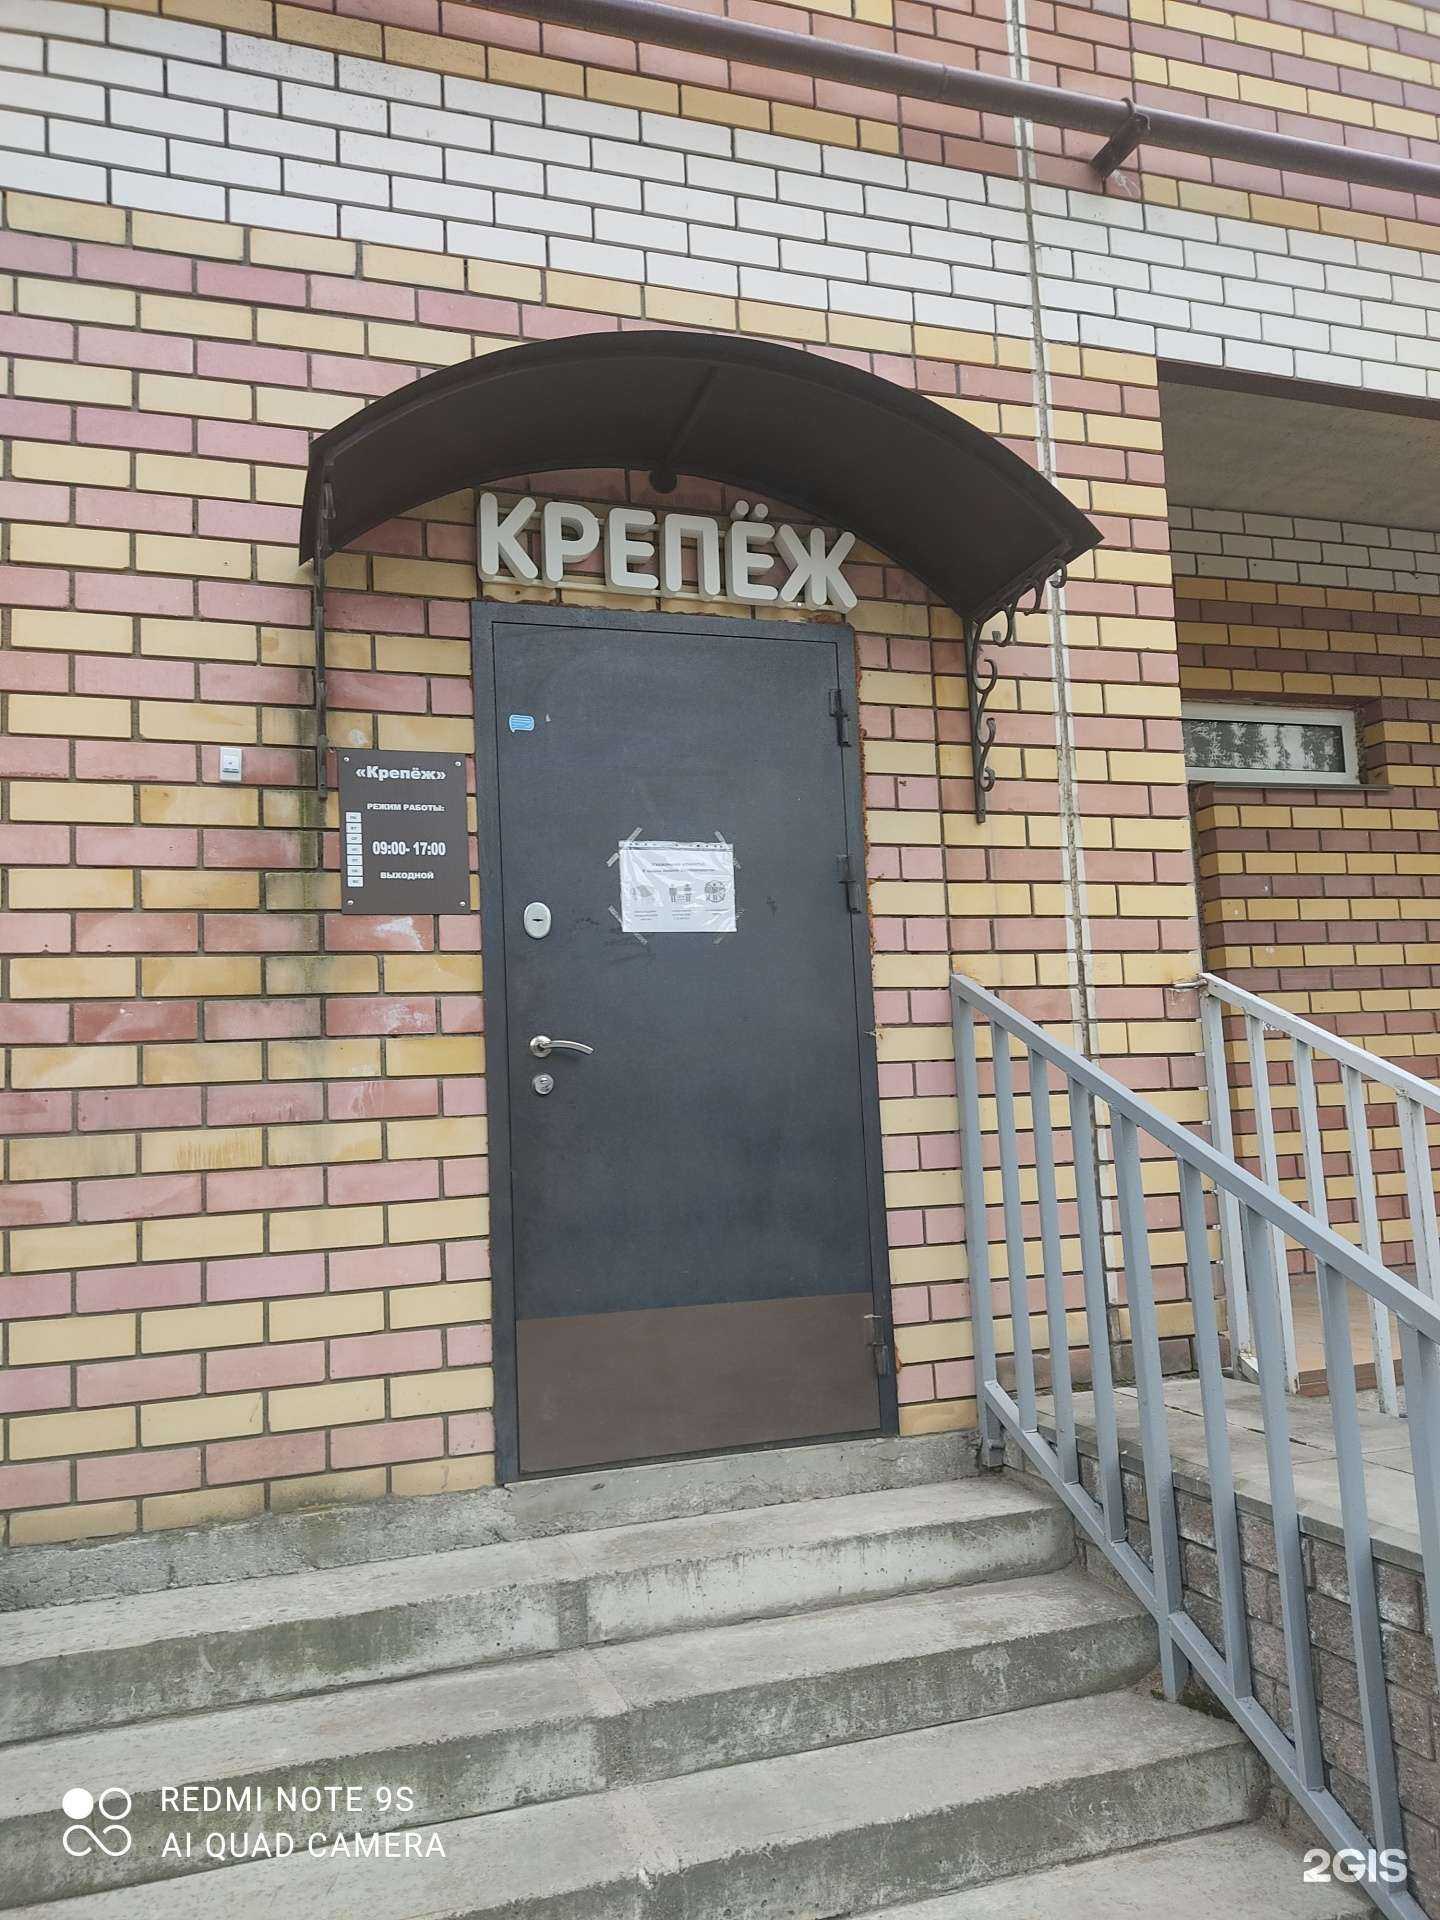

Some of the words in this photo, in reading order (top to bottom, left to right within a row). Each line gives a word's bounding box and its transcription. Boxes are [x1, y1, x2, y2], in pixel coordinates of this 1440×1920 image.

[478, 492, 858, 613] КРЕПЁЖ
[356, 766, 446, 781] «Крепёж»
[367, 803, 401, 811] РЕЖИМ
[403, 804, 445, 812] РАБОТЫ:
[413, 841, 446, 856] 17:00
